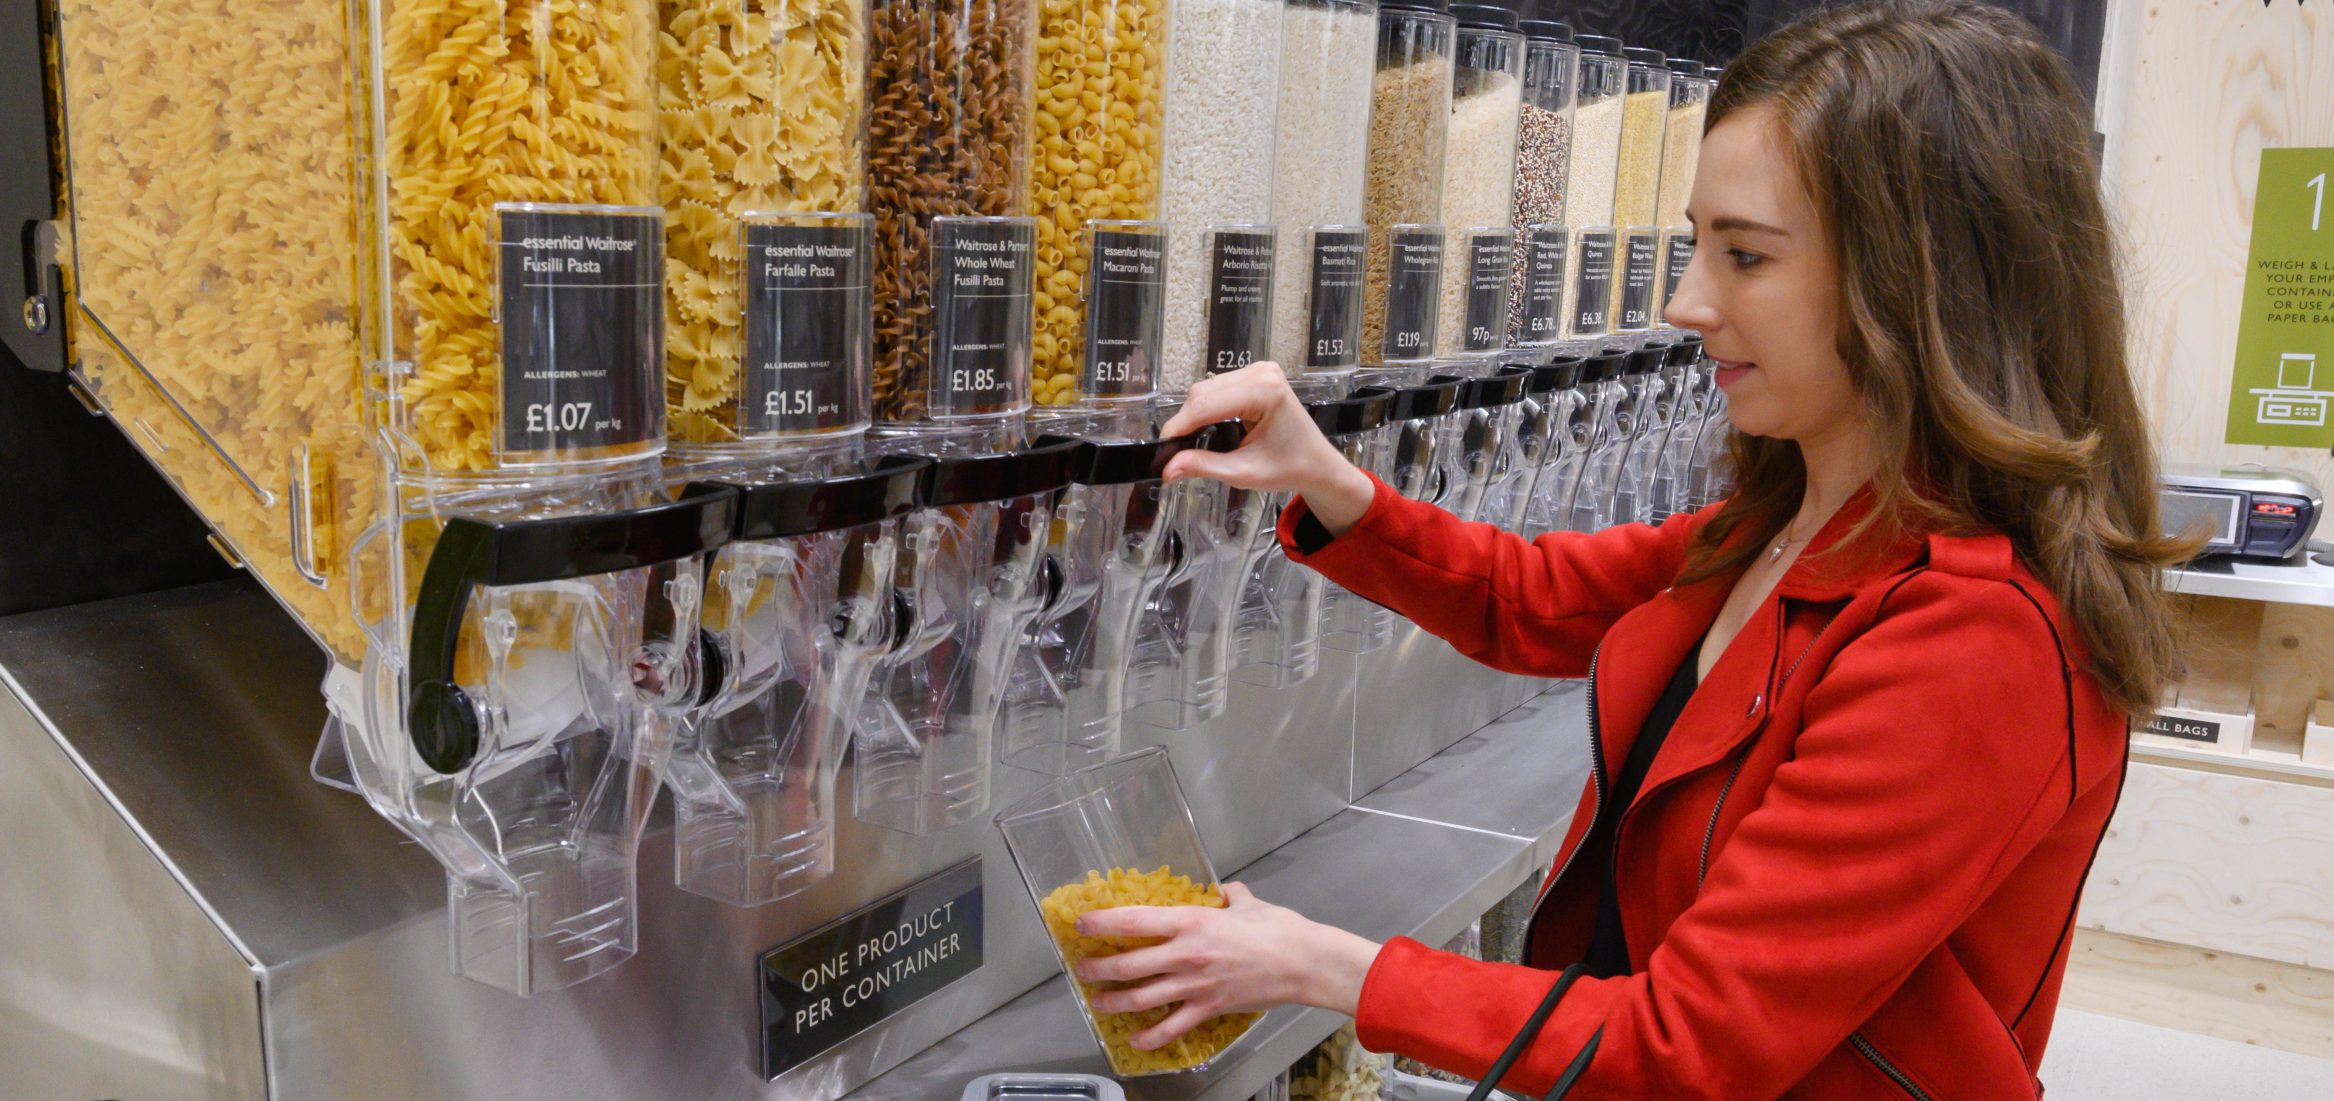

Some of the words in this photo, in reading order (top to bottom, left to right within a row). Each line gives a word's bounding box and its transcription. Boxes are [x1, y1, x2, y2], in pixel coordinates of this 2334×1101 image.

[2306, 172, 2326, 232] 1
[522, 235, 583, 250] essential
[955, 238, 998, 251] Waitrose
[999, 240, 1006, 252] &
[1223, 243, 1254, 255] Waitrose
[765, 243, 814, 257] essential
[1104, 247, 1138, 258] essential
[523, 256, 563, 272] Fusilli
[567, 257, 601, 273] Pasta
[954, 256, 988, 269] Whole
[989, 257, 1016, 269] Wheat
[1103, 260, 1139, 273] Macaroni
[1222, 259, 1250, 269] Arborio
[1477, 255, 1491, 265] Long
[2258, 260, 2304, 271] WEIGH
[2310, 261, 2318, 270] &
[765, 263, 807, 277] Farfalle
[809, 264, 835, 277] Pasta
[954, 273, 981, 286] Fusilli
[982, 274, 1004, 286] Pasta
[2266, 273, 2303, 283] YOUR
[2266, 287, 2334, 297] CONTAIN
[2273, 300, 2292, 310] OR
[2298, 301, 2323, 311] USE
[1582, 312, 1602, 325] £6.38
[1626, 310, 1645, 322] £2.04
[2267, 313, 2306, 323] PAPER
[1531, 317, 1553, 331] £6.78
[1397, 331, 1420, 347] £1.19
[1472, 326, 1489, 344] 97p
[1316, 339, 1343, 356] £1.53
[810, 360, 831, 368] WHEAT
[1217, 350, 1252, 368] £2.63
[523, 370, 579, 379] ALLERGENS:
[580, 369, 608, 378] WHEAT
[1095, 361, 1130, 382] £1.51
[952, 368, 995, 391] £1.85
[765, 389, 813, 415] £1.51
[818, 405, 830, 415] per
[830, 402, 839, 414] kg
[526, 402, 592, 432] £1.07
[595, 420, 610, 432] per
[611, 417, 622, 431] kg
[2174, 723, 2208, 736] BAGS
[801, 951, 849, 993] ONE
[858, 900, 954, 967] PRODUCT
[795, 997, 834, 1034] PER
[842, 933, 961, 1008] CONTAINER
